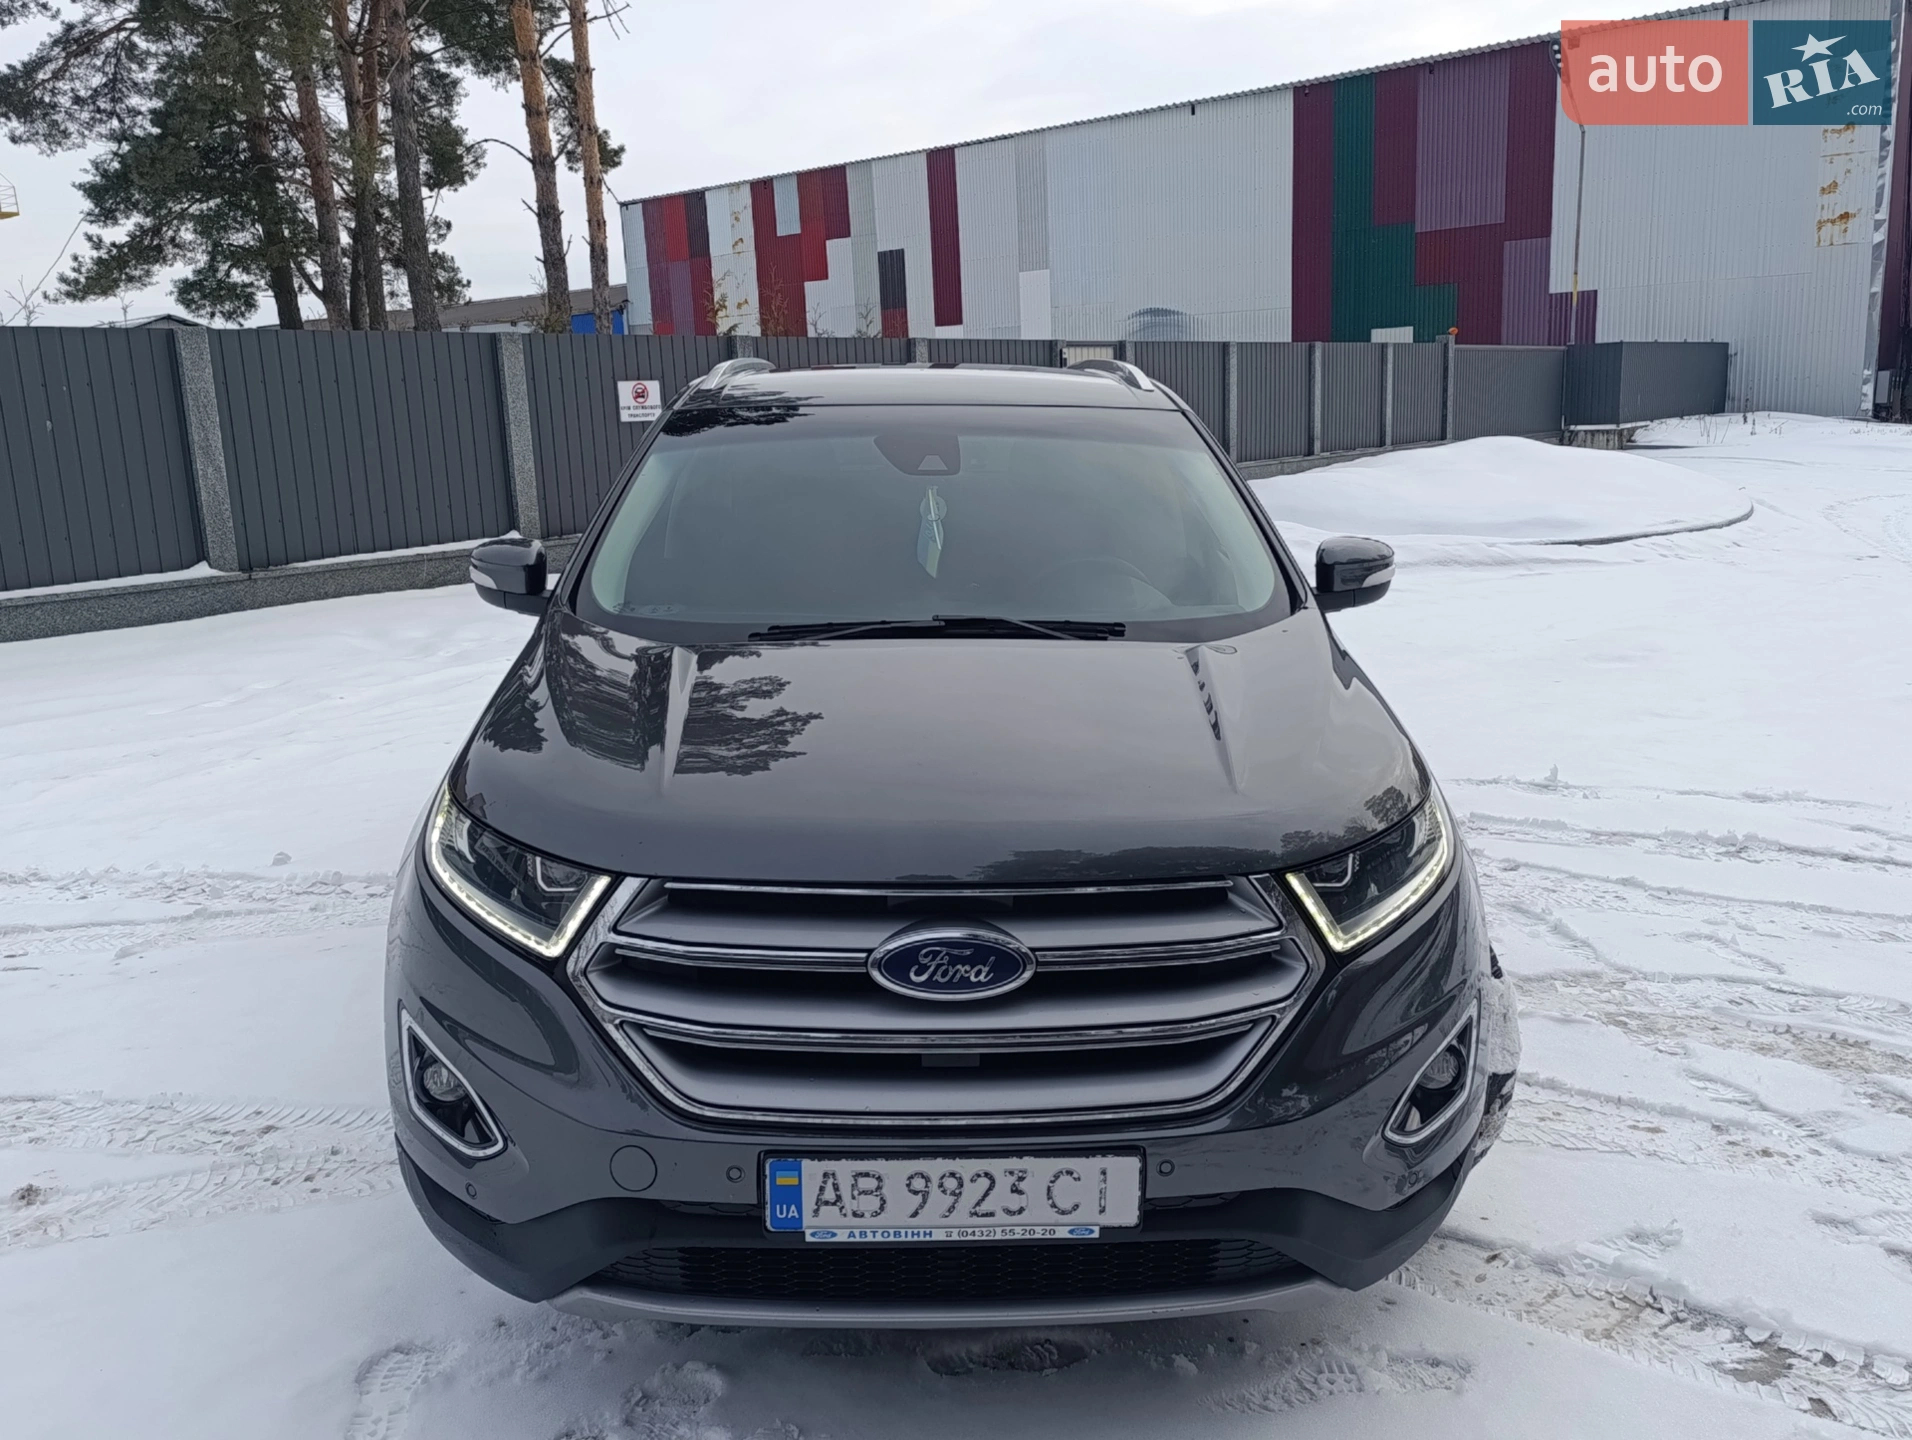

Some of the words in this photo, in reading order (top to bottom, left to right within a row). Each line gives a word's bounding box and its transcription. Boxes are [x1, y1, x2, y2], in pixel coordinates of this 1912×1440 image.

[909, 947, 996, 983] Ford
[811, 1169, 889, 1219] AB
[904, 1168, 1029, 1219] 9923
[1045, 1167, 1109, 1216] CI
[775, 1204, 799, 1219] UA
[814, 1230, 833, 1239] Ford
[847, 1230, 933, 1239] АВТОВІНН
[957, 1228, 997, 1238] (0432)
[1000, 1228, 1056, 1237] 55-20-20
